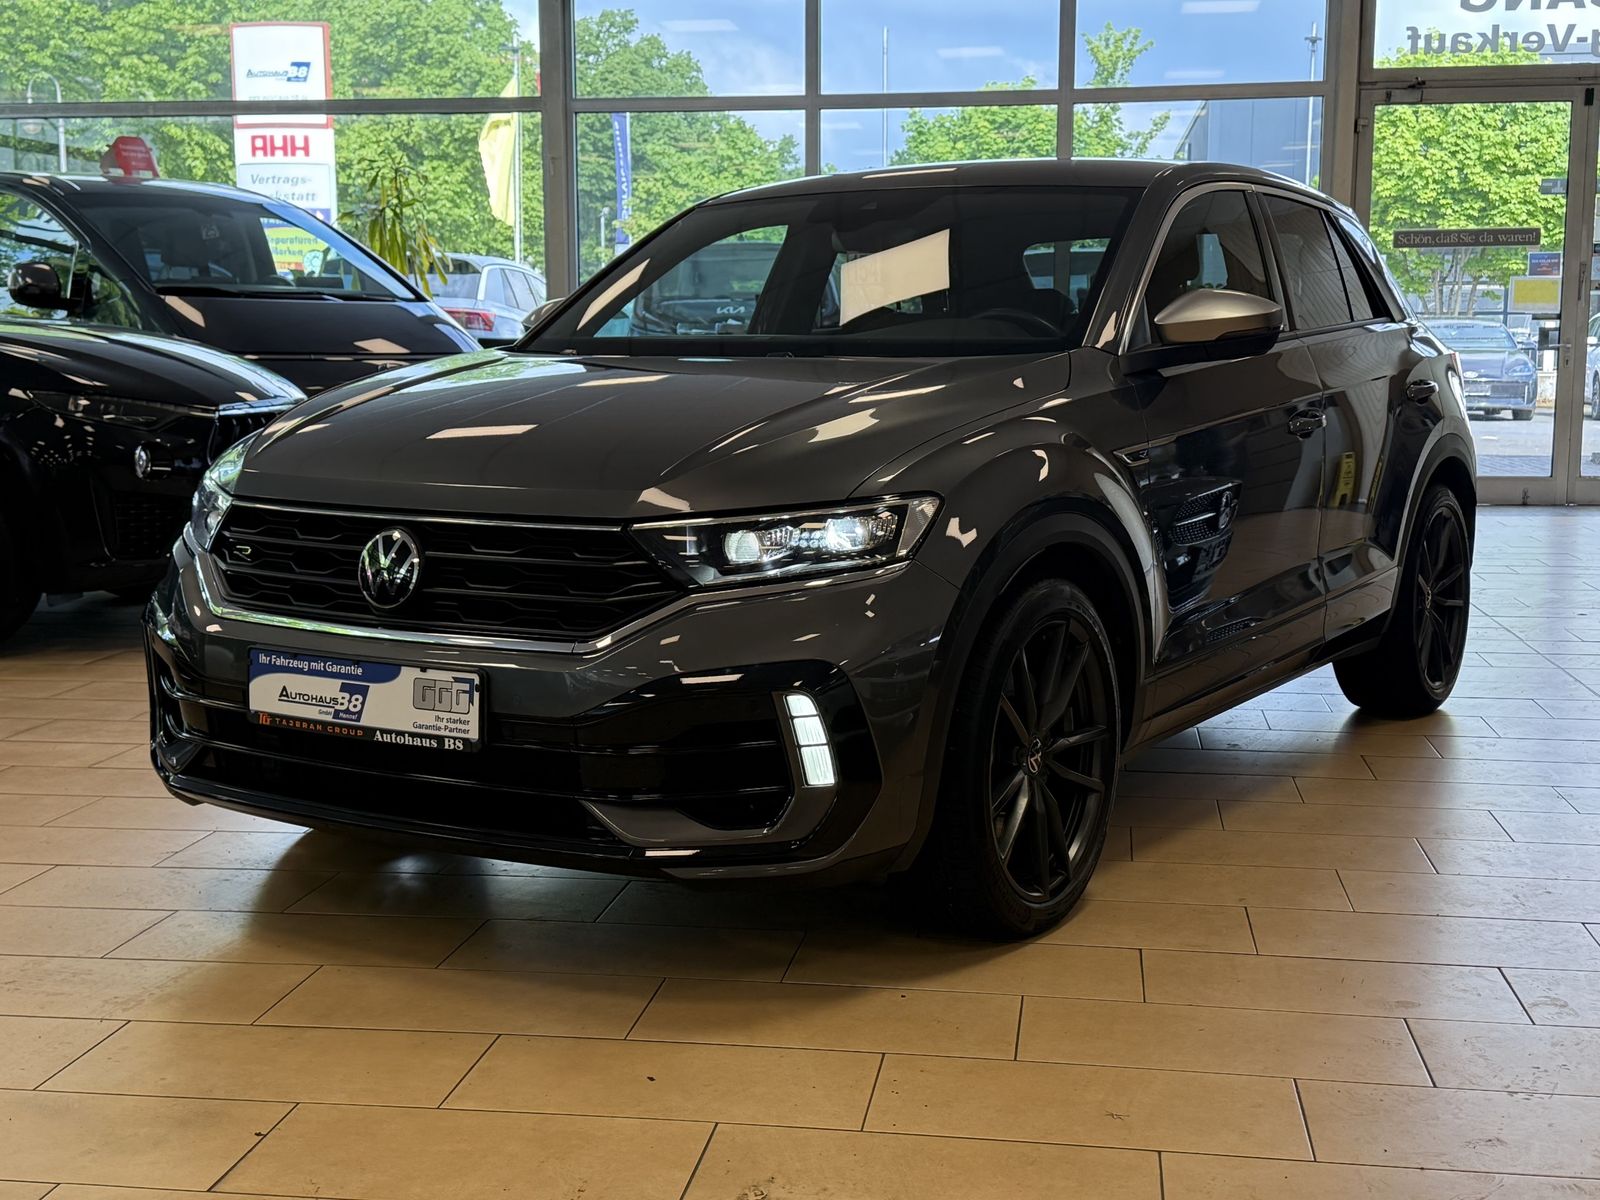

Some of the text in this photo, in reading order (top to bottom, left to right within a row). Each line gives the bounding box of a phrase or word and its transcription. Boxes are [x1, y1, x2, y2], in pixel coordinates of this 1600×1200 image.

[251, 135, 310, 157] AHH
[251, 174, 312, 186] Vertrags-
[270, 190, 317, 201] kstatt
[1460, 231, 1475, 243] Sie
[1479, 231, 1494, 243] da
[1498, 231, 1536, 243] waren!
[258, 653, 363, 675] Ihr Fahrzeug mit Garantie
[413, 677, 474, 715] GGG
[434, 714, 470, 726] Ihr starker
[326, 725, 364, 736] GROUP
[413, 722, 470, 735] Garantie-Partner
[374, 730, 464, 750] Autohaus B8
